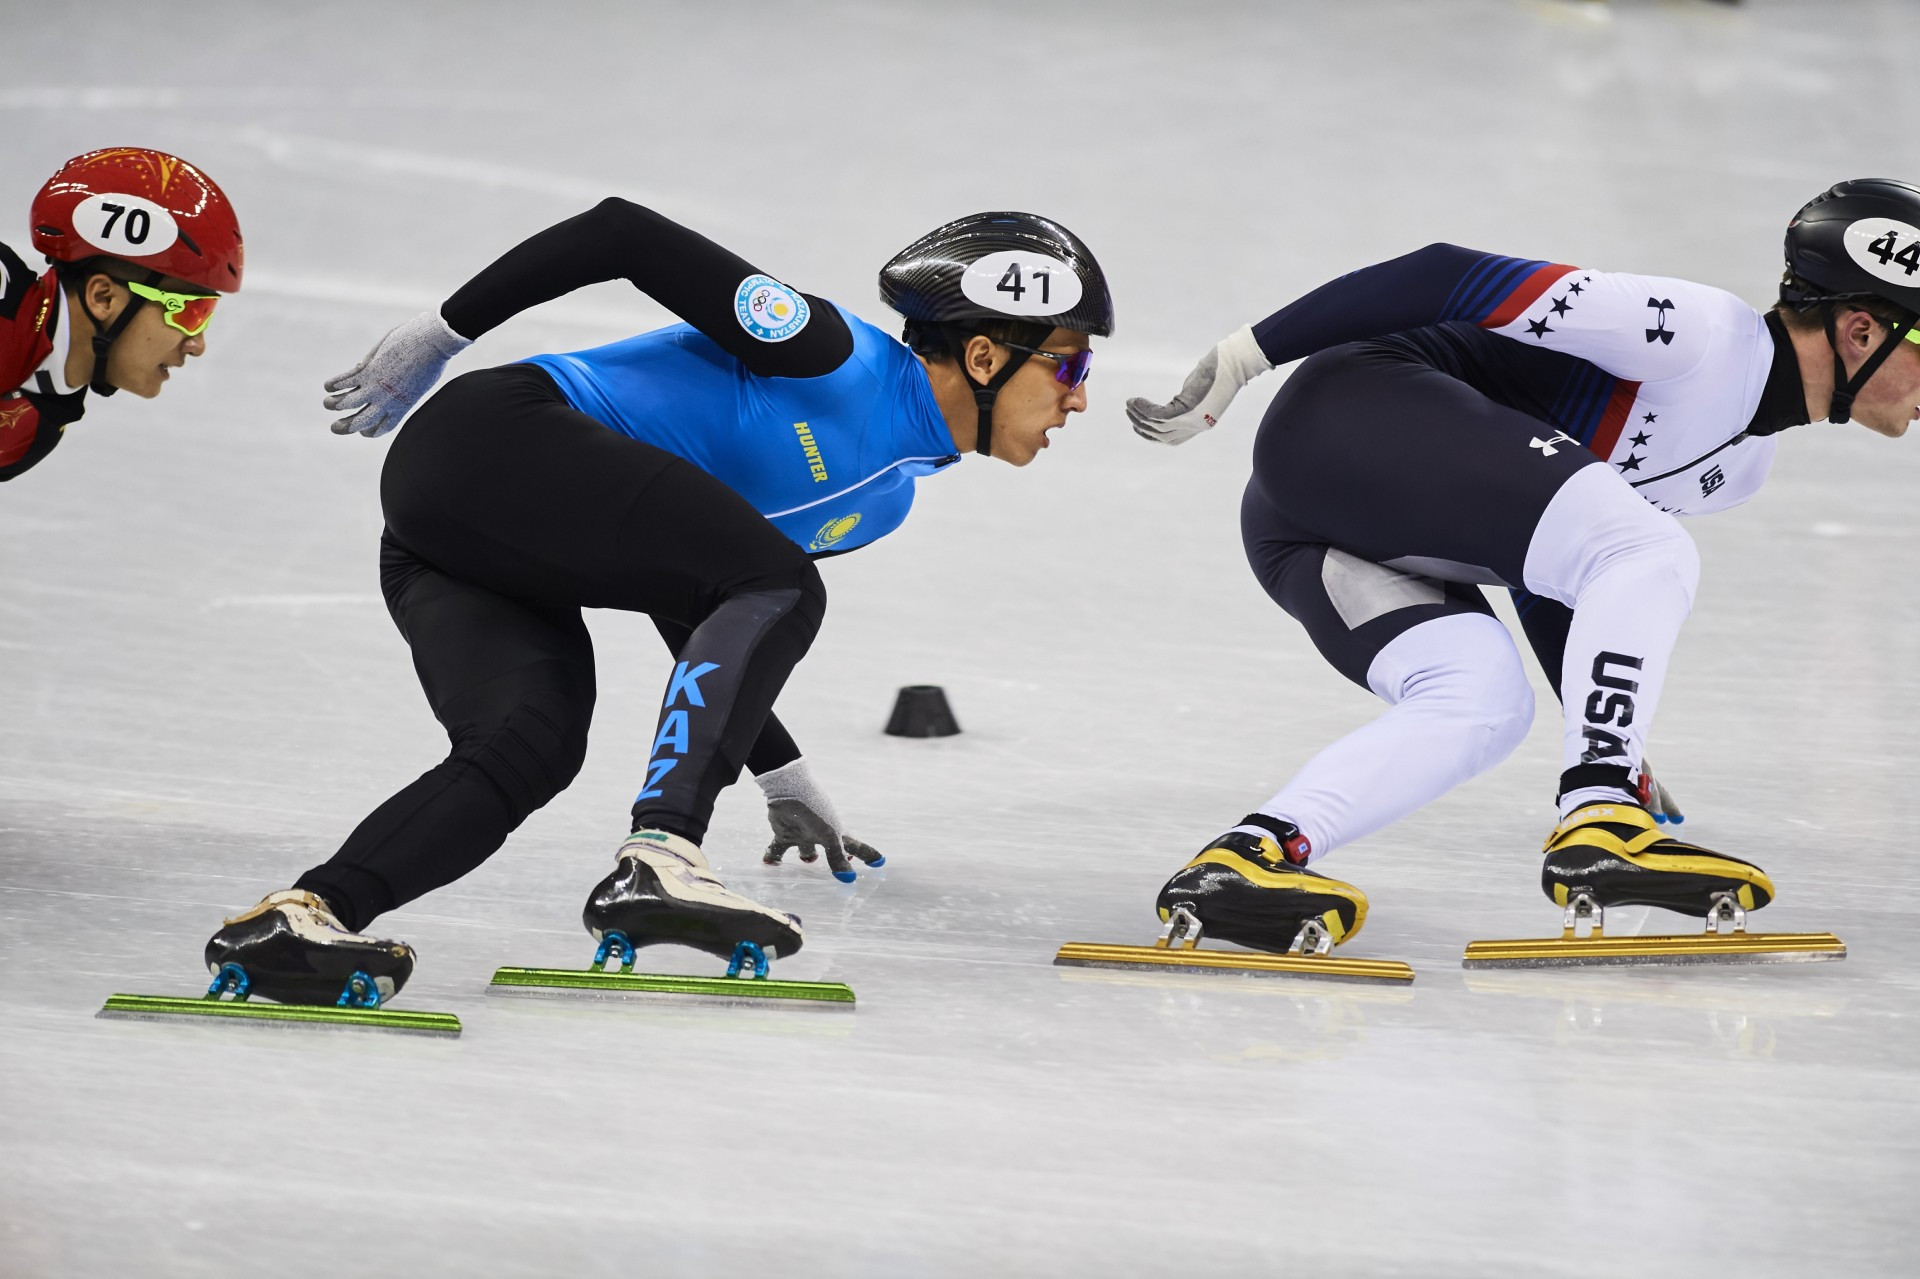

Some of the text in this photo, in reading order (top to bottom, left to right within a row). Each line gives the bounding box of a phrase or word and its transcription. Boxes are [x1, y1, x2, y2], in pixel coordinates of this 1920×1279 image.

[101, 203, 151, 245] 70
[1867, 230, 1920, 276] 44
[996, 263, 1050, 304] 41
[739, 300, 753, 327] TEAM
[793, 421, 828, 483] HUNTER
[1699, 464, 1725, 498] USA
[1581, 650, 1644, 765] USA
[634, 660, 721, 804] KAZ
